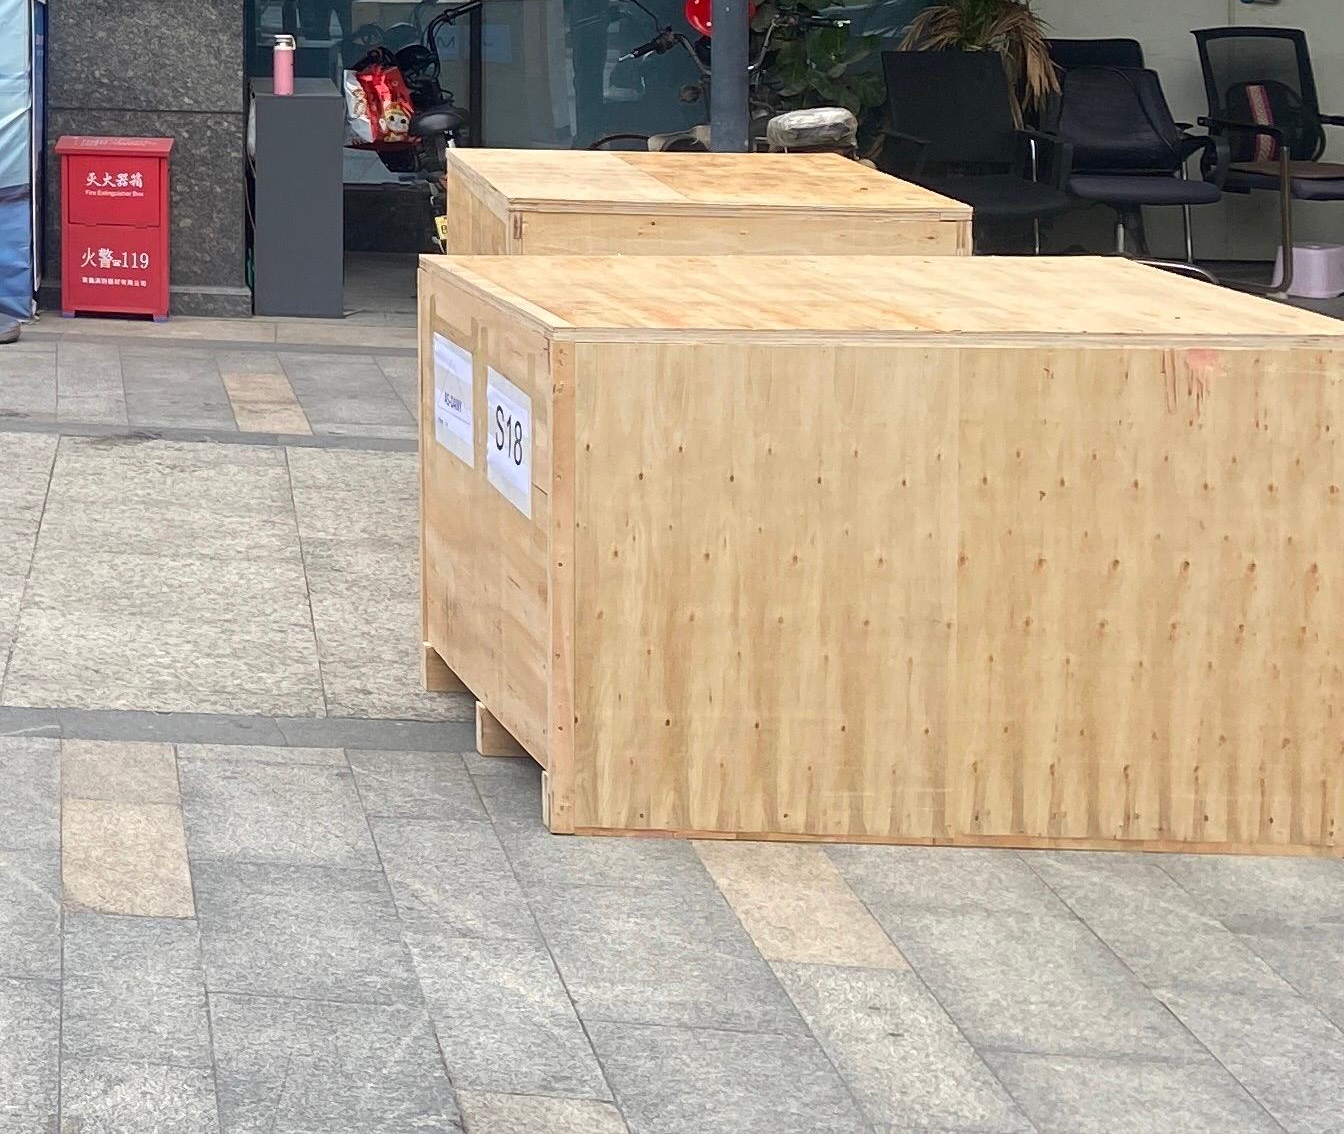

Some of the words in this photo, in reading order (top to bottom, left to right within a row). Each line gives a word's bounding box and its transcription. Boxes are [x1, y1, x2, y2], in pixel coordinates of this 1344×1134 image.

[86, 171, 143, 188] 灭火器箱
[80, 247, 113, 269] 火警
[122, 251, 149, 269] 119
[495, 404, 523, 466] S18
